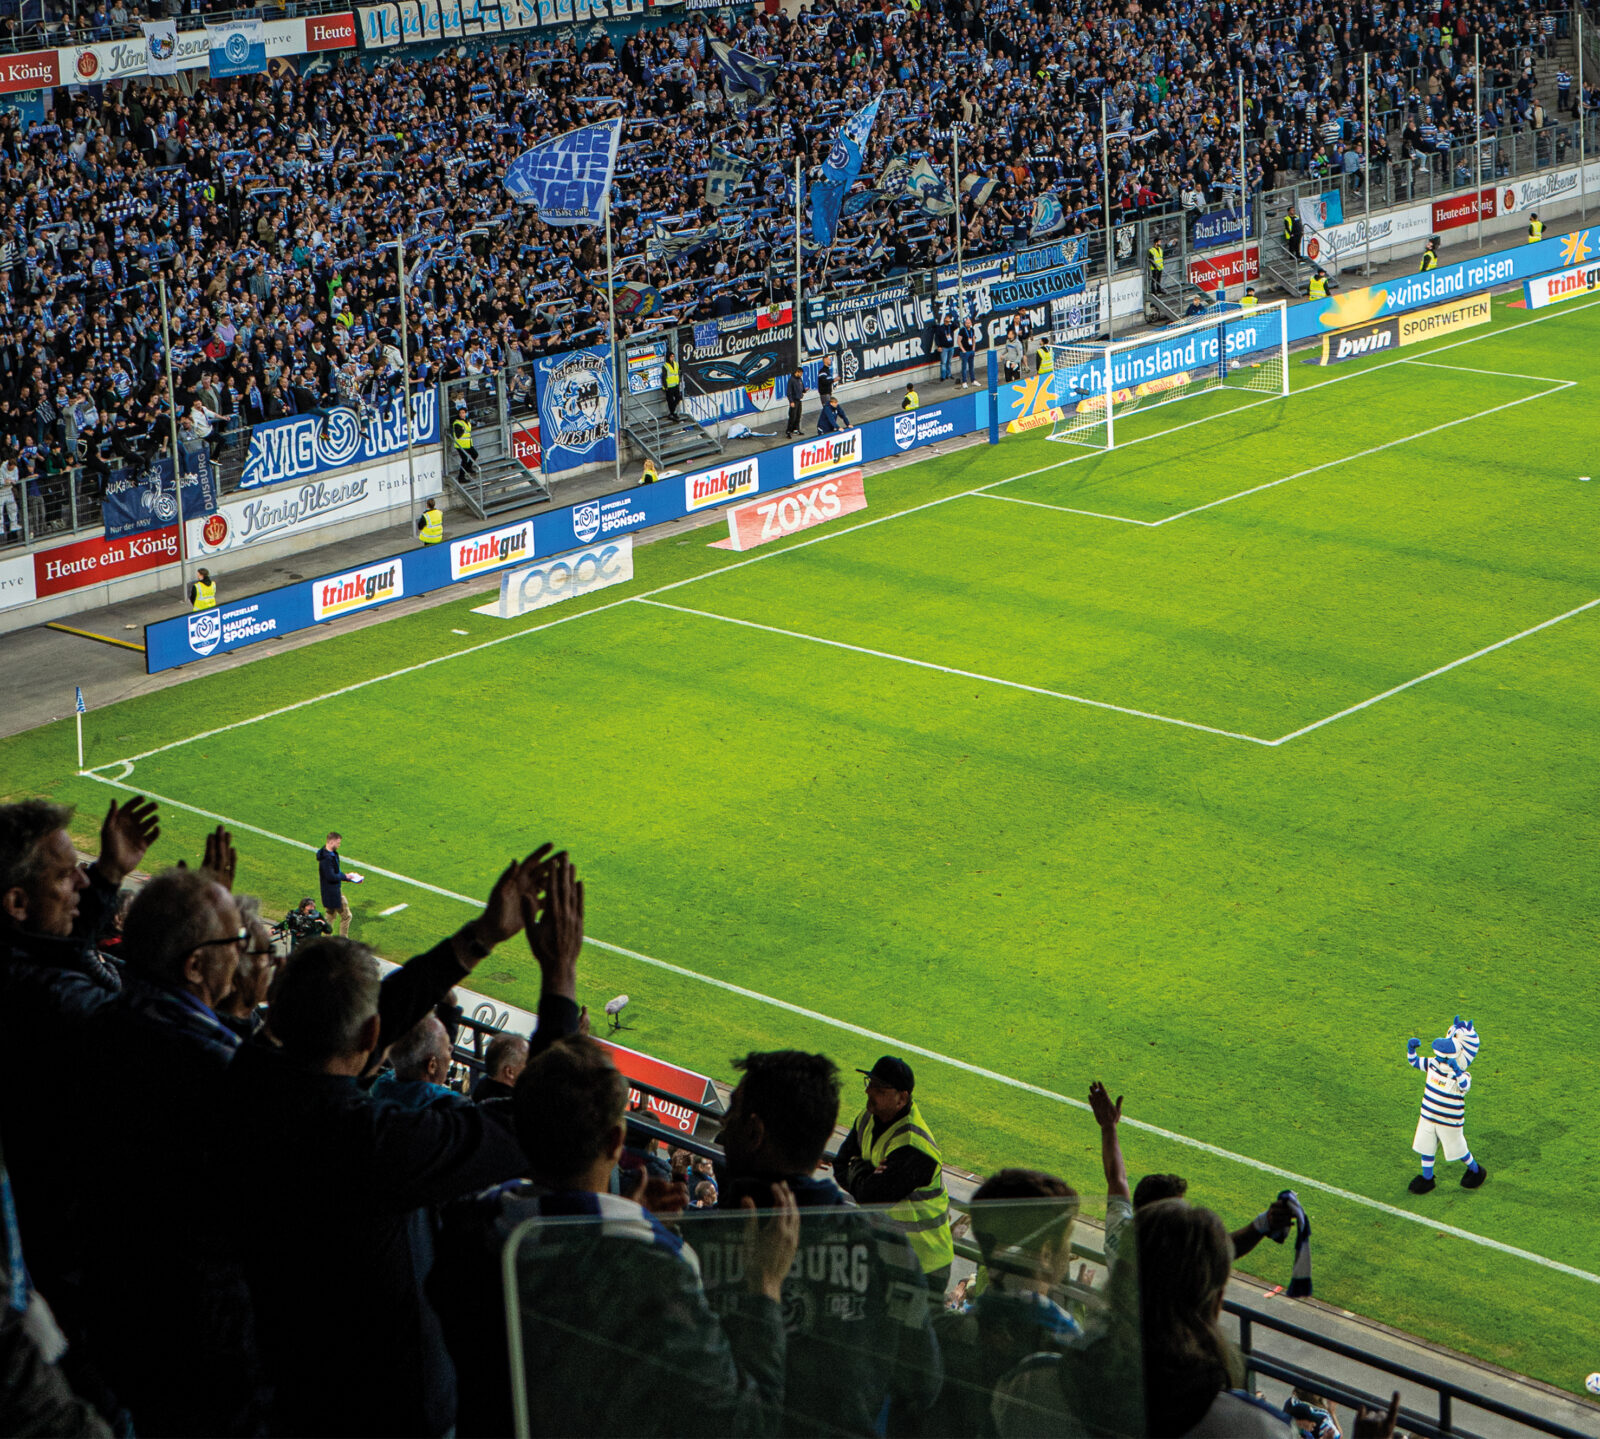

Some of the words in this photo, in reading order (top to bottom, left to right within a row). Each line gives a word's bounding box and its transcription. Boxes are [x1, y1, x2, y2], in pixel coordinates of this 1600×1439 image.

[313, 24, 352, 41] Heute
[8, 62, 53, 83] König
[1521, 182, 1547, 205] König
[1545, 173, 1578, 193] Pilsener
[1436, 208, 1459, 223] Heute
[1458, 205, 1471, 218] ein
[1471, 198, 1493, 215] Knig
[1326, 229, 1357, 255] König
[1396, 217, 1428, 231] Fankurve
[1190, 267, 1217, 285] Heute
[1216, 264, 1231, 278] ein
[1468, 258, 1514, 286] reisen
[990, 267, 1084, 306] WEDAUSTADION
[1100, 290, 1140, 306] Fnkurve
[1052, 290, 1098, 312] RUHRPOTT
[682, 336, 724, 362] Proud
[726, 324, 794, 355] Generation
[1200, 325, 1256, 362] resen
[1337, 328, 1392, 359] bwin
[1403, 302, 1488, 336] SPORTWETTEN
[863, 337, 925, 371] IMMER
[917, 419, 940, 432] HAUPT-
[917, 422, 954, 441] SPONSOR
[1017, 414, 1048, 432] Sinalco
[513, 440, 541, 459] Heu
[801, 434, 857, 469] trinkgut
[197, 453, 214, 511] DUISBURG
[693, 464, 753, 498] trinkgut
[241, 500, 301, 536] König
[299, 477, 369, 516] Pilsener
[601, 498, 632, 511] OFFIZIELLER
[601, 508, 629, 522] HAUPT-
[756, 482, 842, 541] ZOXS
[602, 511, 646, 532] SPONSOR
[46, 553, 97, 581] Heute
[100, 547, 124, 566] ein
[129, 533, 177, 558] König
[459, 527, 527, 568] trinkgut
[322, 565, 396, 608] trinkgut
[222, 604, 259, 620] OFFIZIELLER
[222, 616, 256, 633] HAUPT-
[223, 618, 277, 643] SPONSOR
[701, 1242, 869, 1294] DUBURG
